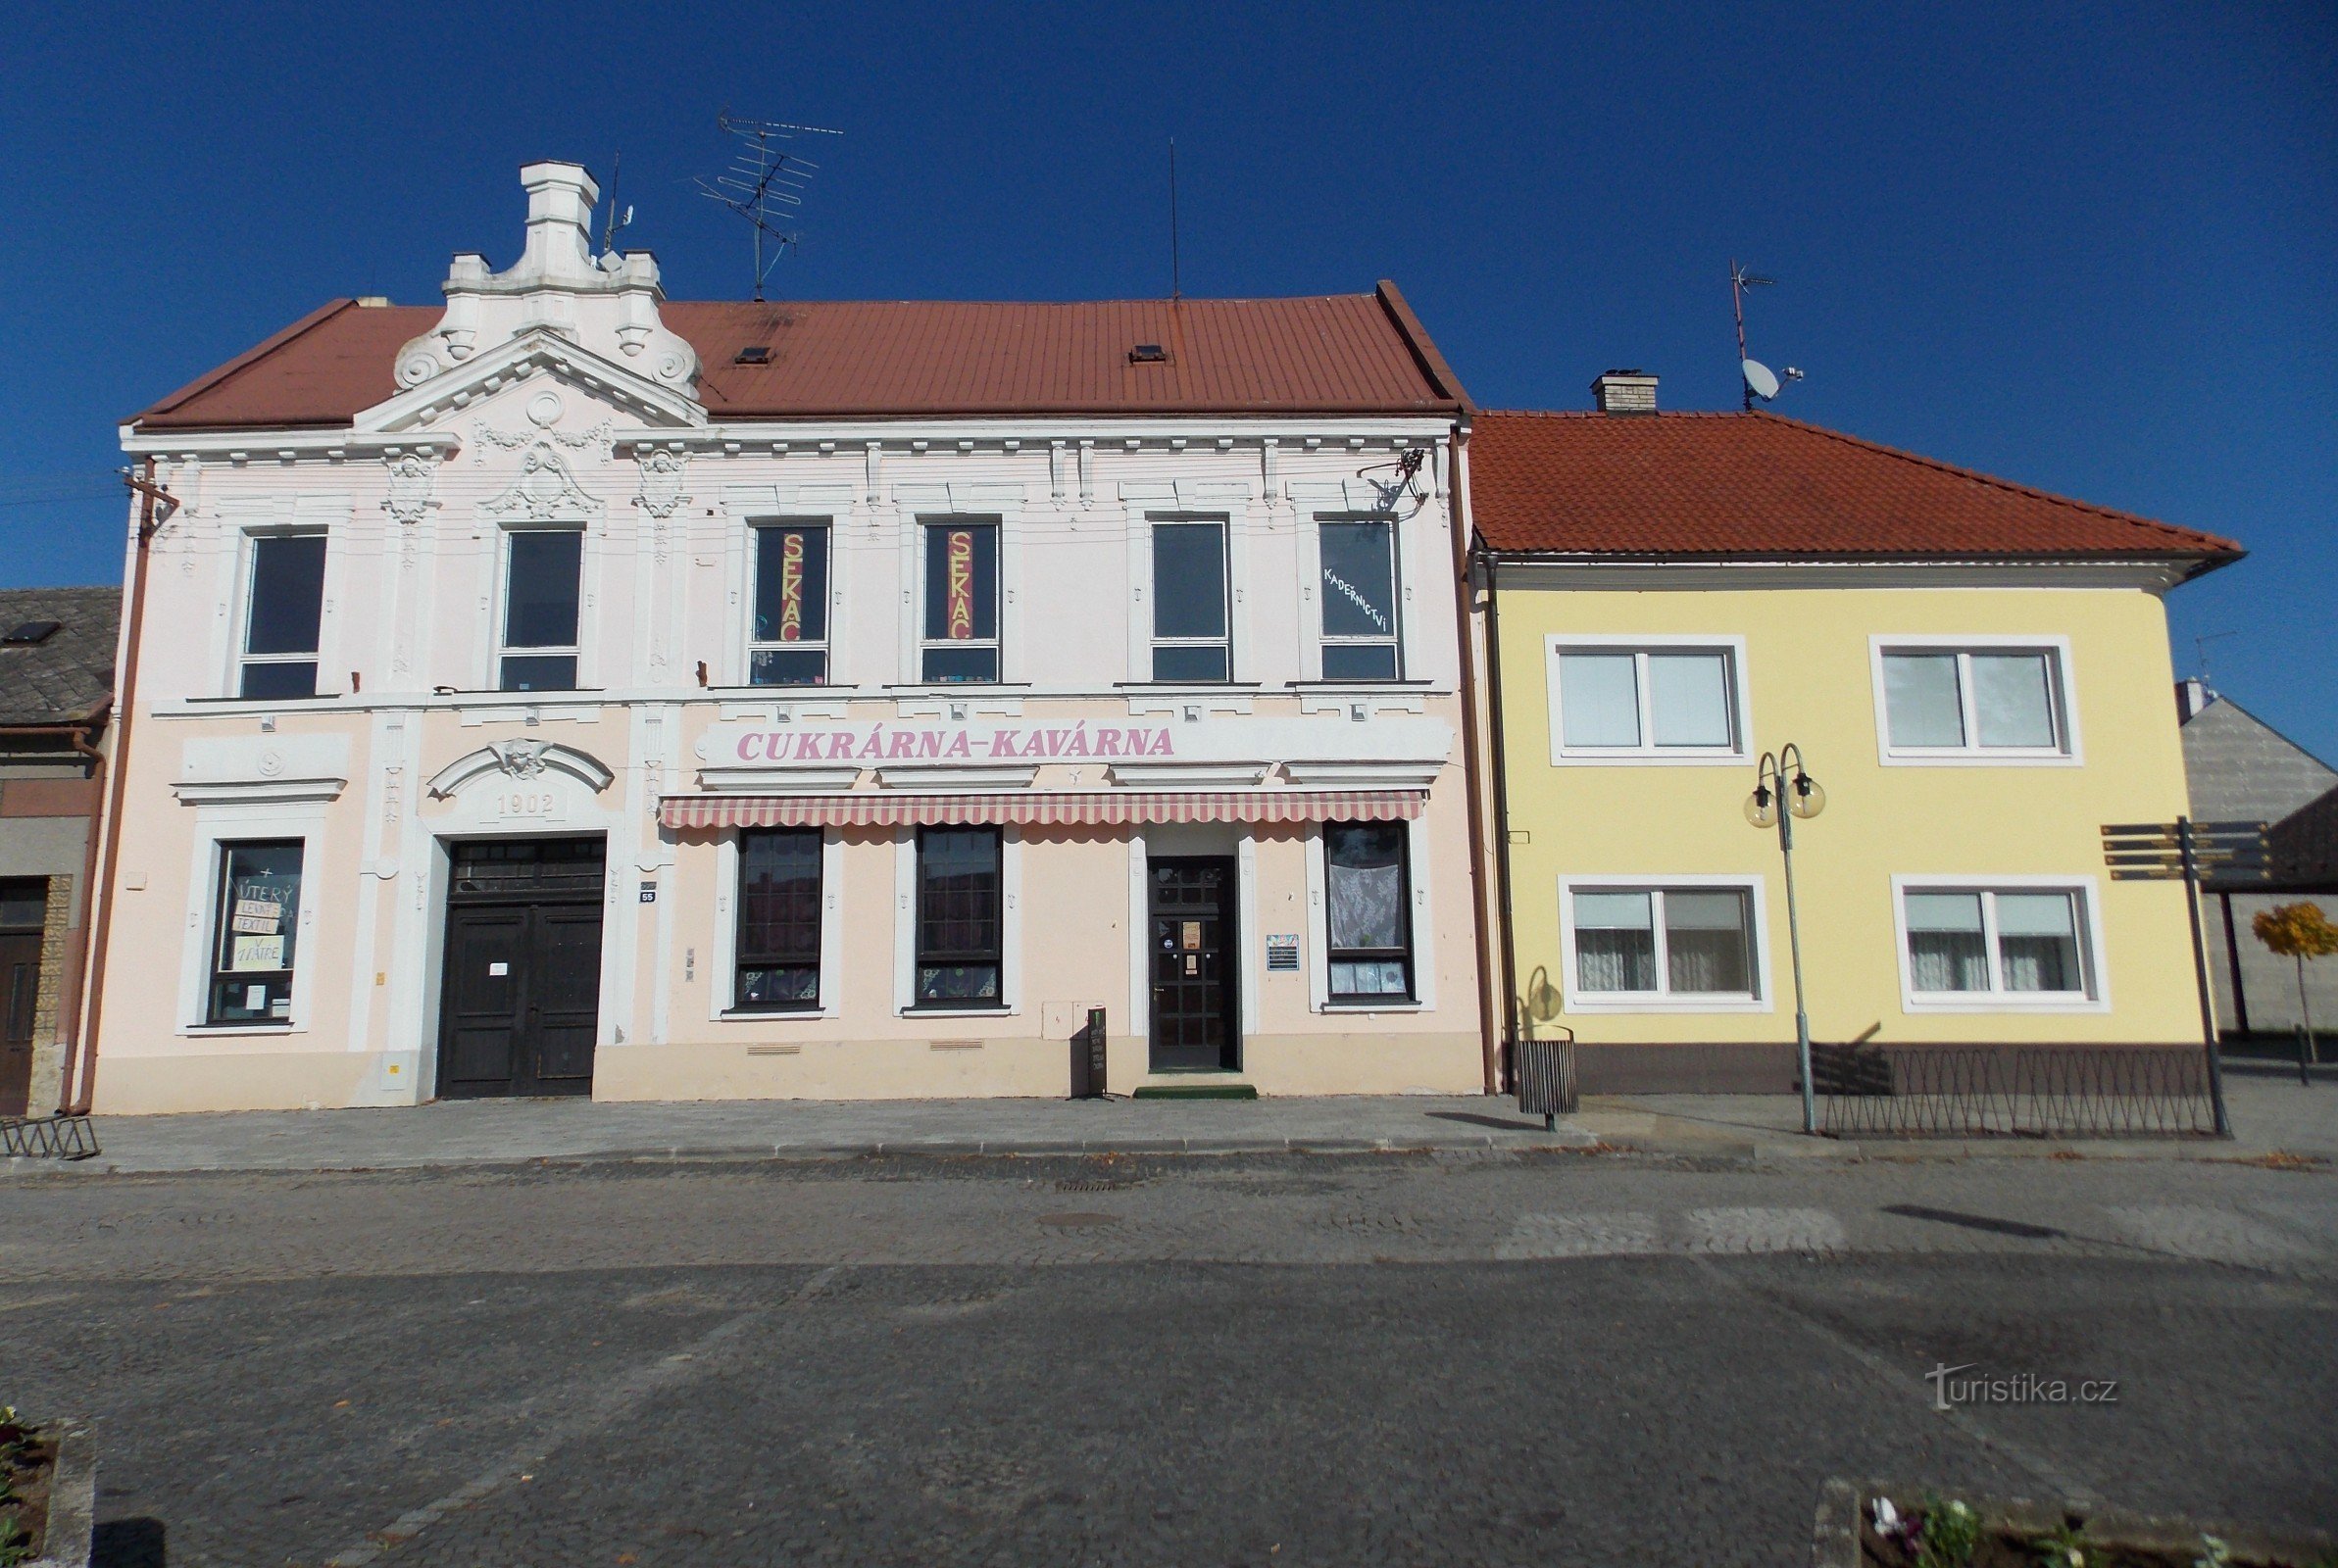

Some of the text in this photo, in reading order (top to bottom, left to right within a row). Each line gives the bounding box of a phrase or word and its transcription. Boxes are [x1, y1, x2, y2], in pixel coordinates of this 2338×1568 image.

[498, 793, 553, 813] 1902
[239, 879, 293, 903] ÚTERÝ
[642, 893, 654, 902] 55
[237, 917, 272, 932] TEXTIL
